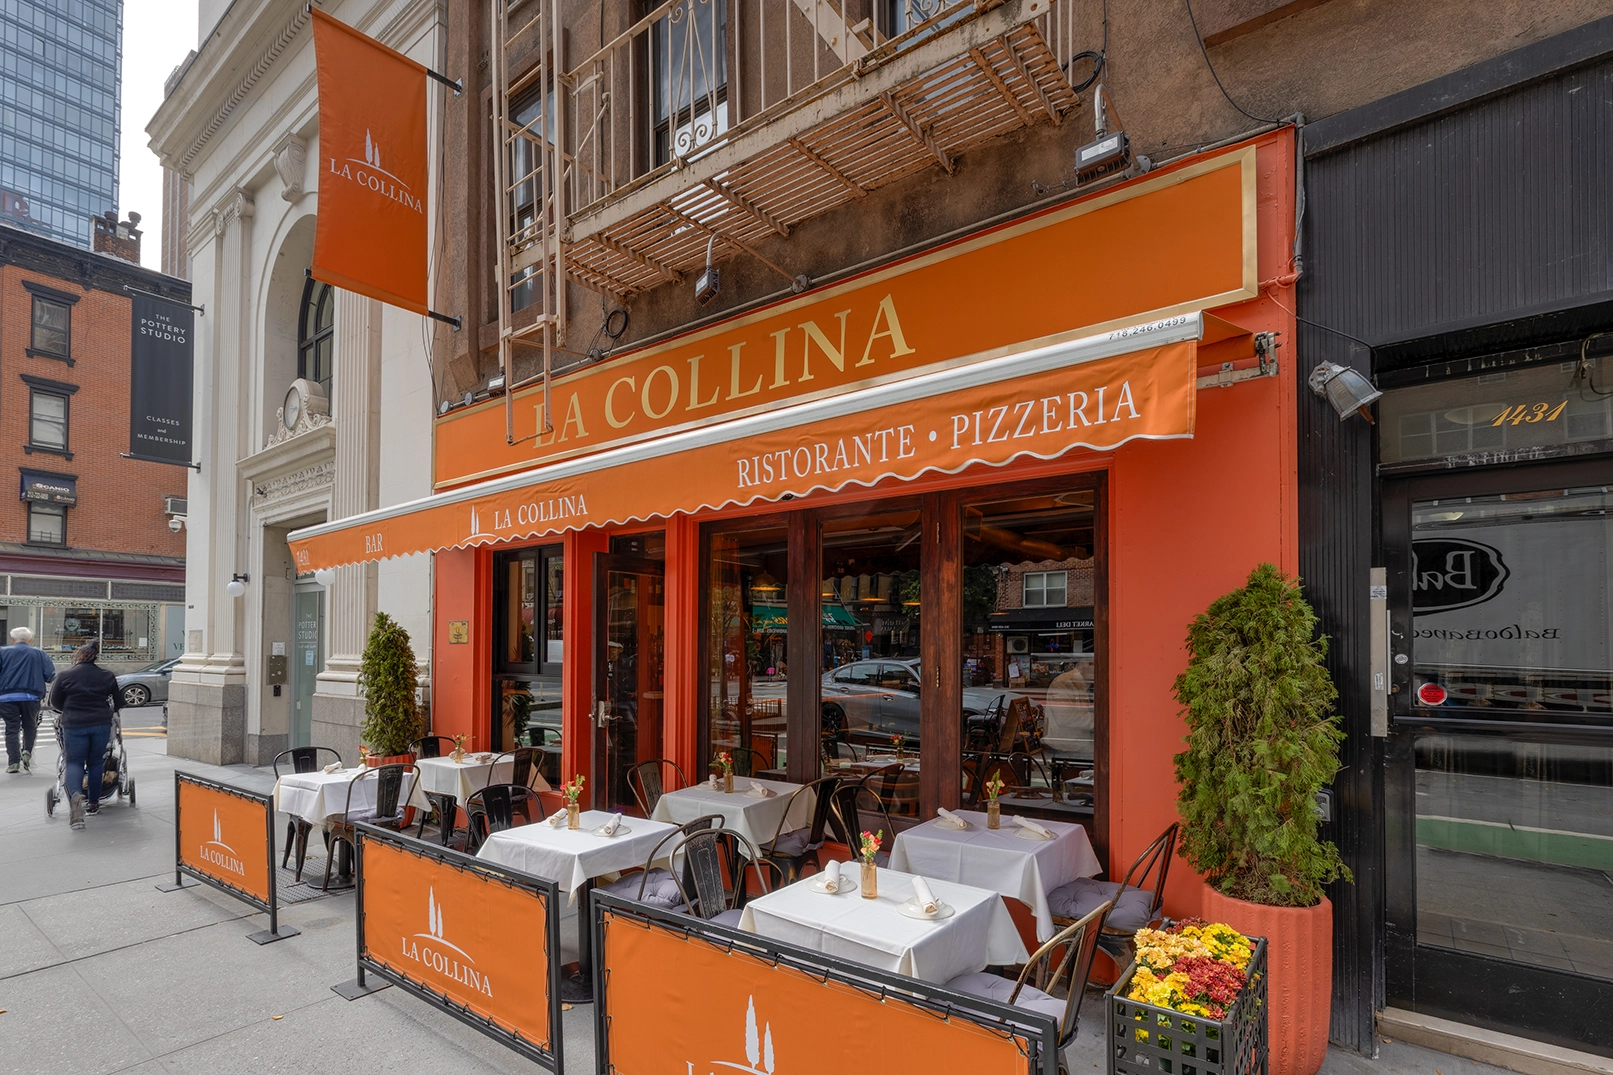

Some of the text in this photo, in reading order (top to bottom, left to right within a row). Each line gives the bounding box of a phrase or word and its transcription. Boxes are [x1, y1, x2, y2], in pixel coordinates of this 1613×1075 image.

[330, 157, 423, 214] LA COLLINA
[141, 318, 186, 334] POTTERY
[155, 313, 170, 322] THE
[1108, 316, 1187, 341] 718.246.0499
[140, 327, 186, 344] STUDIO
[533, 293, 916, 449] LA COLLINA
[146, 415, 180, 426] CLASSES
[1491, 400, 1569, 427] 1431
[137, 433, 186, 445] MEMBERSHIP
[736, 380, 1141, 488] RISTORANTE PIZZERIA
[494, 493, 588, 530] LA COLLINA
[365, 533, 383, 554] BAR
[200, 845, 245, 877] LA COLLINA
[401, 936, 493, 998] LA COLLINA
